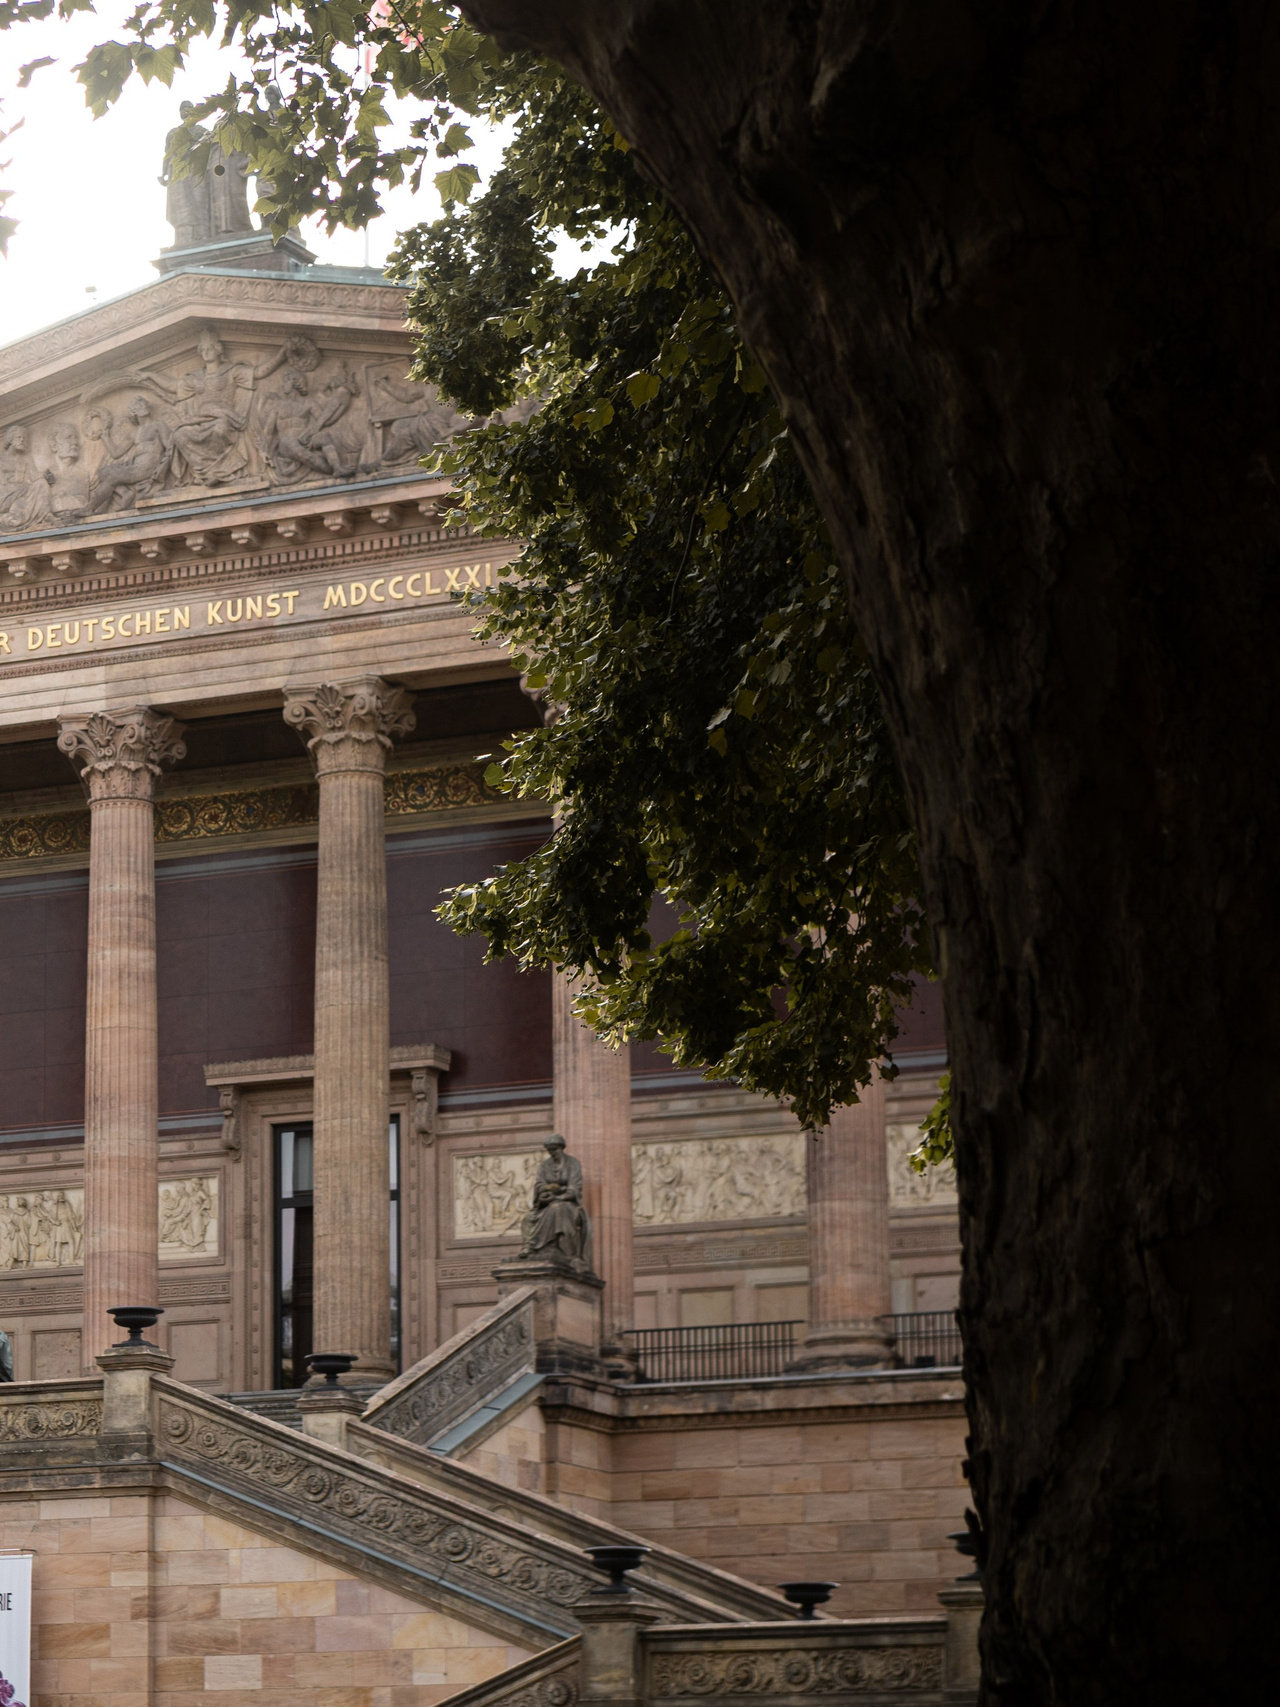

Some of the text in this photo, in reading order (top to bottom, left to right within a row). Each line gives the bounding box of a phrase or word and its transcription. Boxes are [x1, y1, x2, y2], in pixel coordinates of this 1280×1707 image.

[26, 605, 190, 650] DEUTSCHEN
[207, 590, 300, 626] KUNST
[322, 562, 492, 610] MDCCCLXXI
